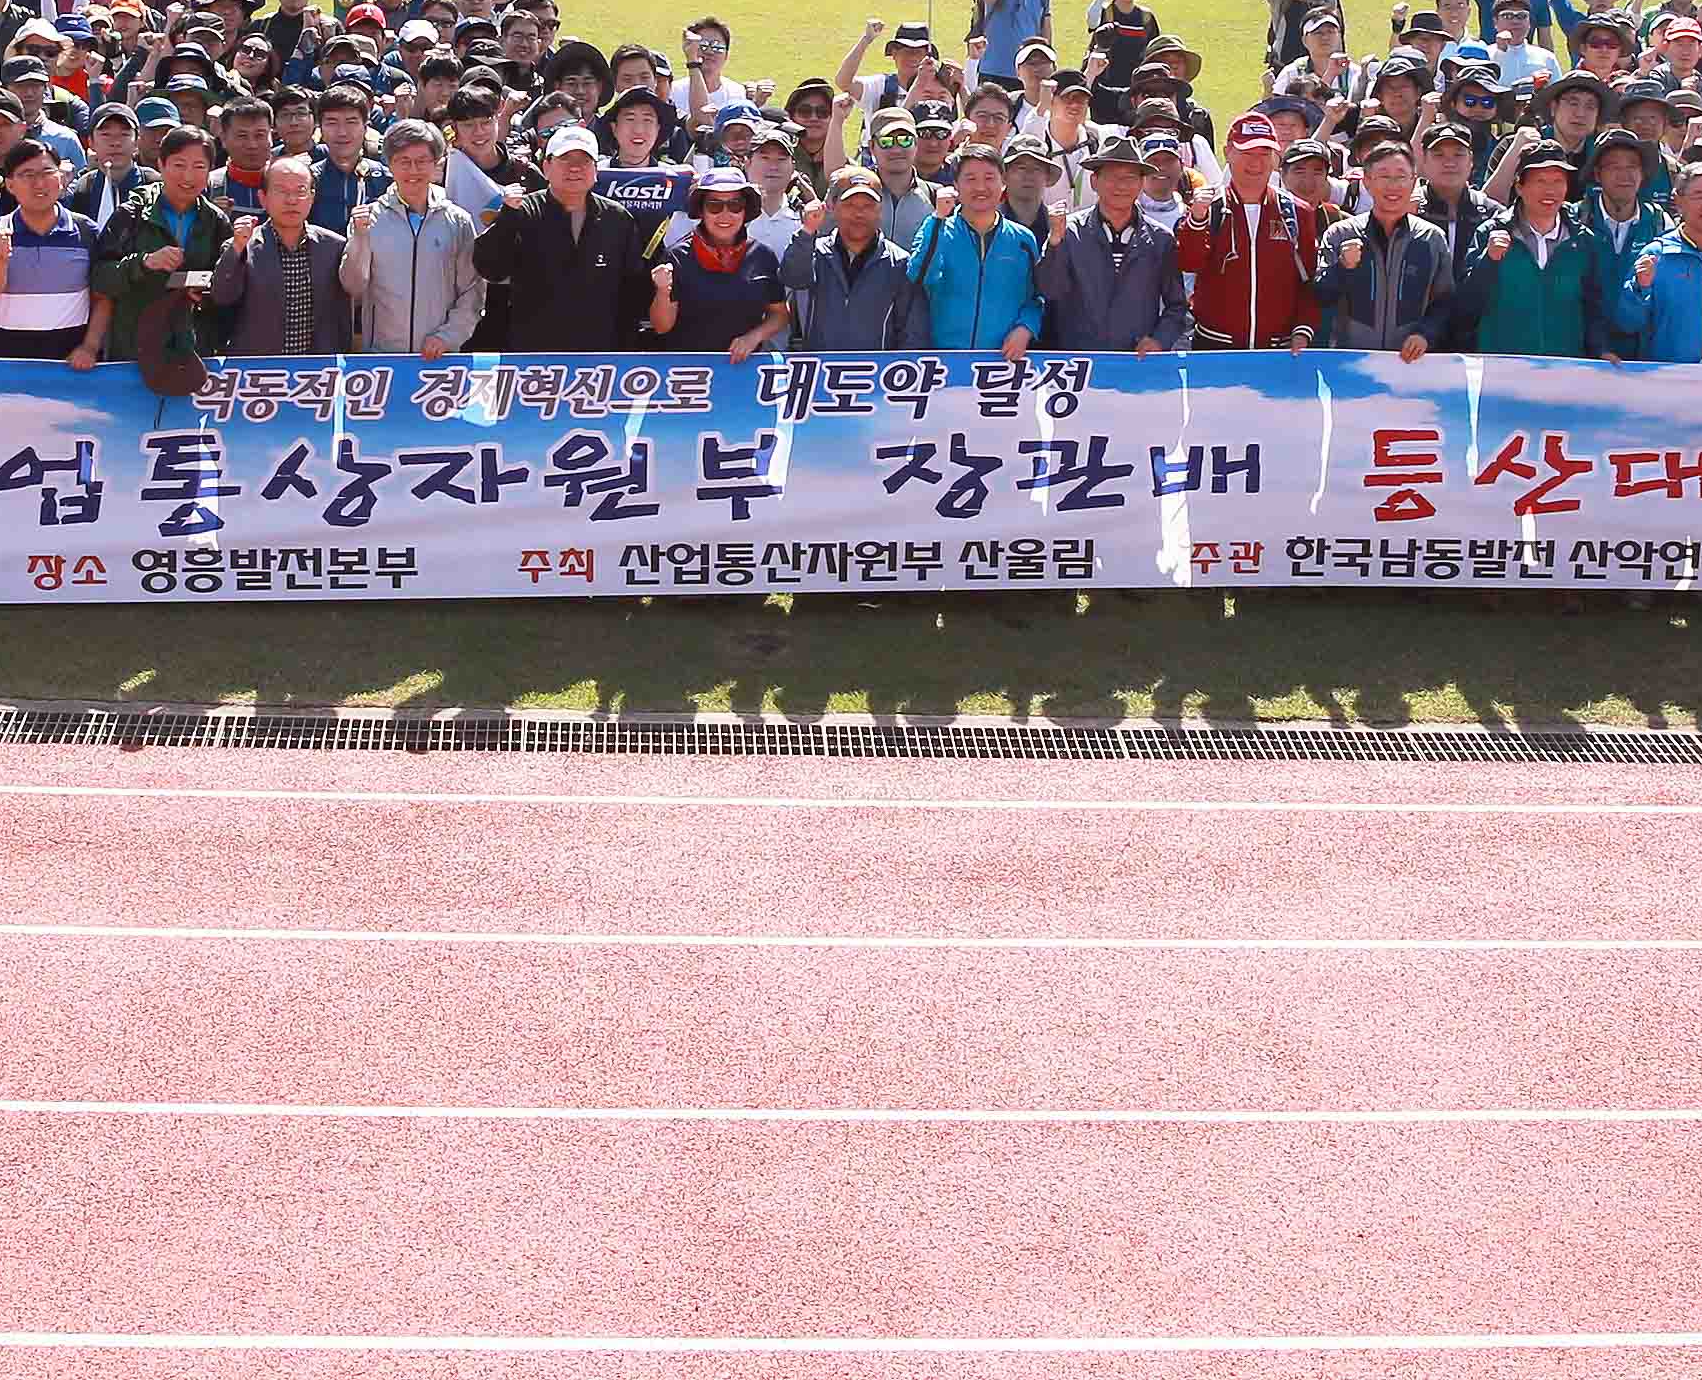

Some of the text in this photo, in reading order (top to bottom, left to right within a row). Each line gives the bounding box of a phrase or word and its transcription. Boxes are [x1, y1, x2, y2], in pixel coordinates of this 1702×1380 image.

[607, 179, 673, 200] kosti
[194, 360, 1090, 420] 역동적인 경제혁신으로 대도약 달성
[875, 433, 1261, 520] 장관배
[26, 554, 108, 588] 장소
[132, 547, 418, 594] 영흥발전본부
[517, 548, 595, 582] 주최
[958, 537, 1095, 582] 산울림
[1190, 540, 1264, 576] 주관
[1285, 534, 1554, 582] 한국남동발전
